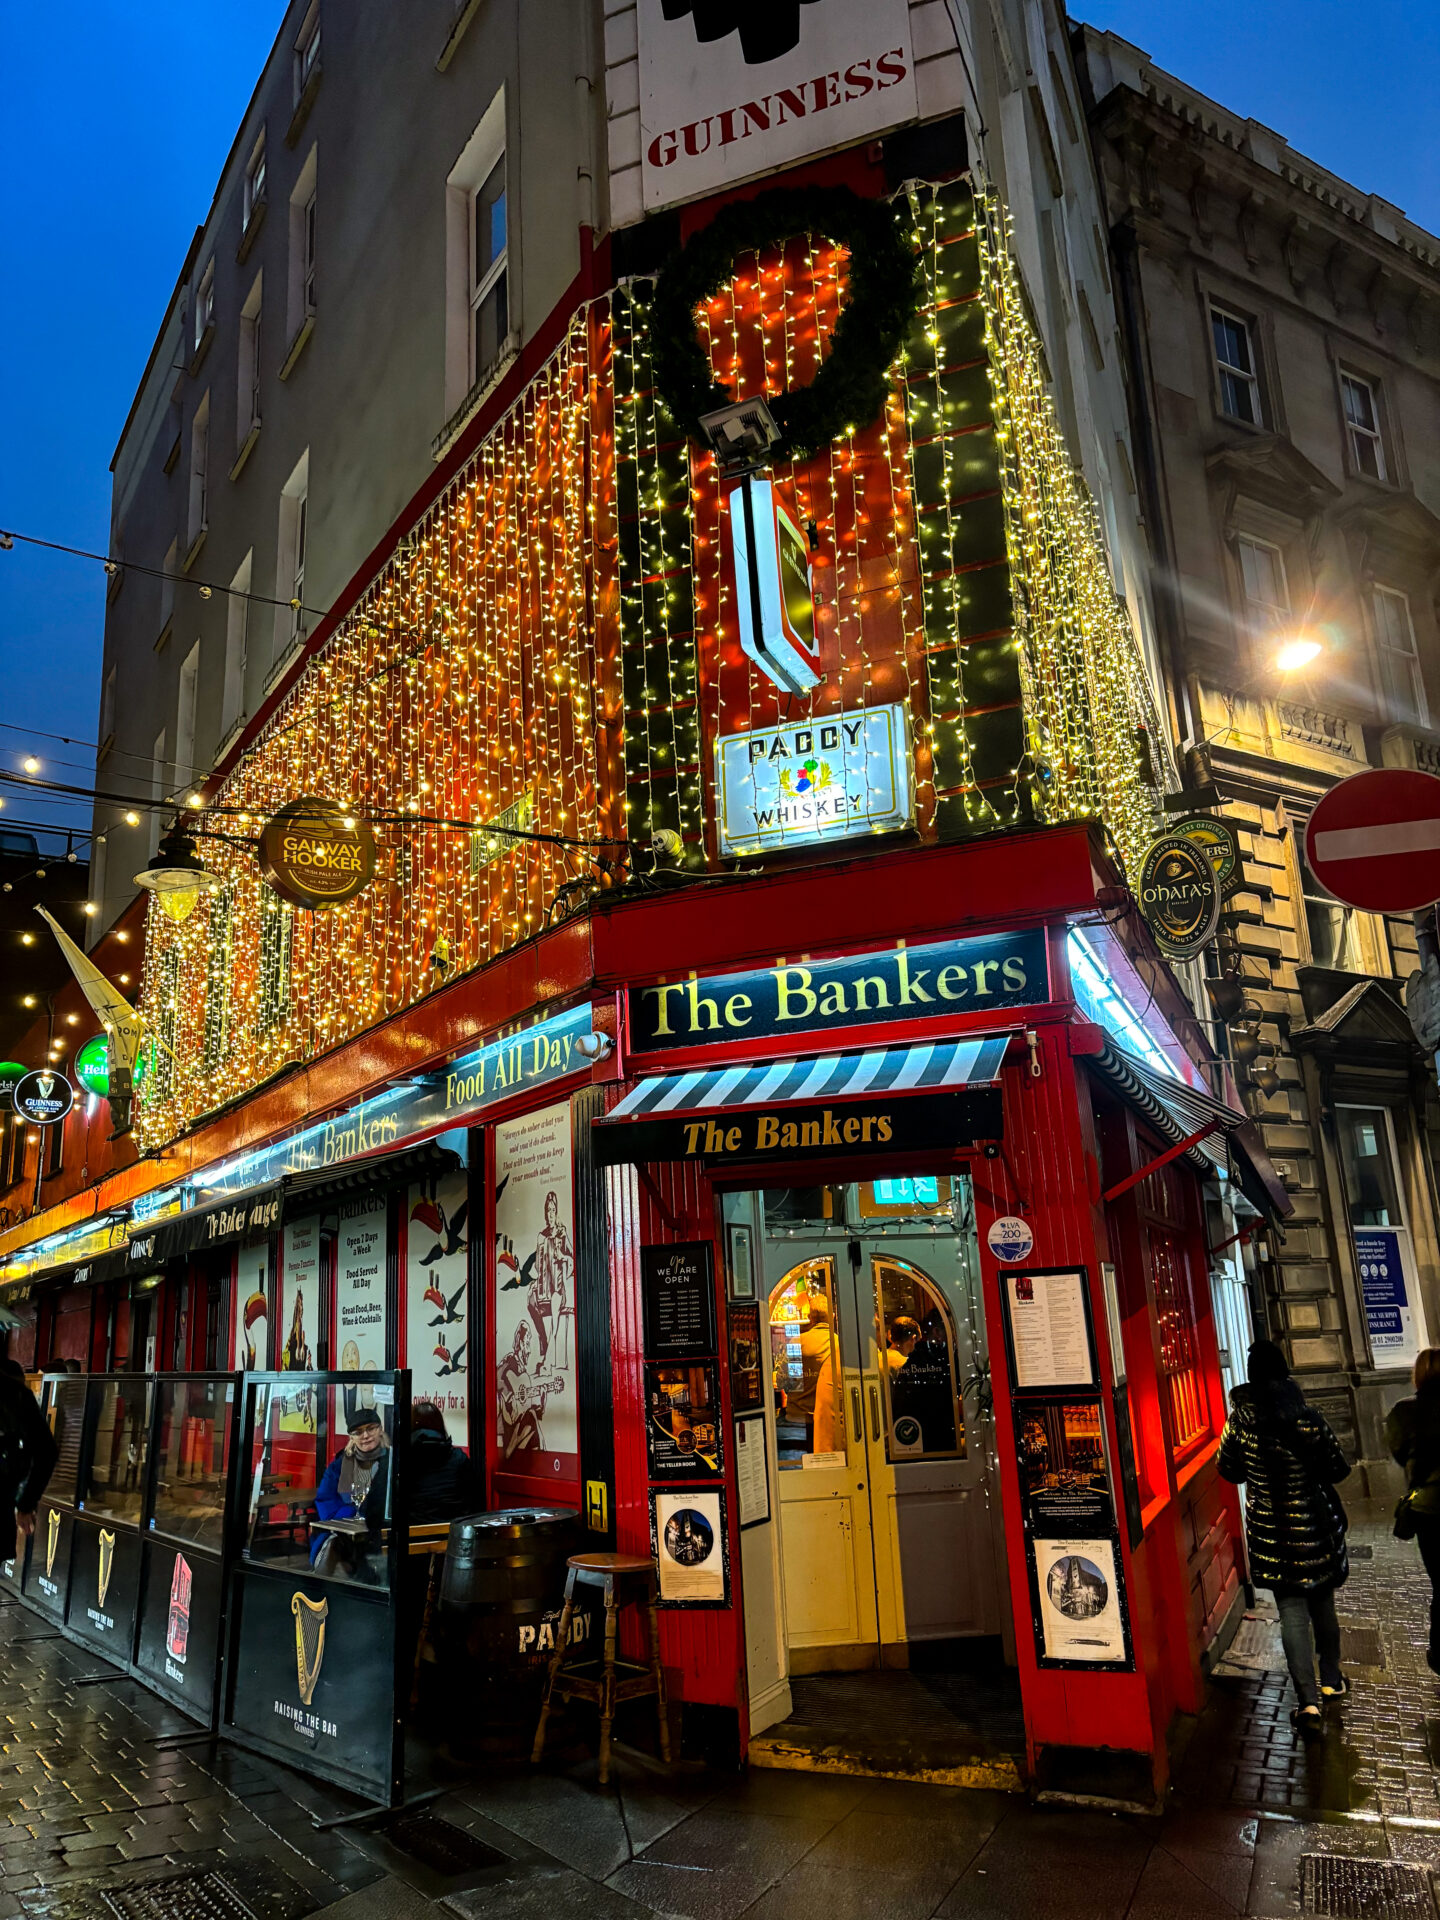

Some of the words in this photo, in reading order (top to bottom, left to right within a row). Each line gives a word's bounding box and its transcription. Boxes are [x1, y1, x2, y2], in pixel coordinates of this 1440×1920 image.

[648, 47, 907, 168] GUINNESS
[749, 720, 863, 766] PADDY
[752, 794, 862, 828] WHISKEY
[1196, 823, 1226, 839] ORIGINAL
[283, 836, 362, 858] GALWAY
[283, 850, 363, 871] HOOKER
[1145, 859, 1157, 880] CRAFT
[1155, 842, 1179, 859] BREWED
[1180, 843, 1189, 851] IN
[1188, 849, 1208, 876] IRELAND
[1152, 918, 1167, 936] IRISH
[1168, 934, 1194, 943] STOUTS
[1199, 913, 1210, 931] ALES
[642, 978, 753, 1037] The
[769, 951, 1028, 1023] Bankers
[445, 1066, 486, 1110] Food
[492, 1046, 523, 1092] All
[532, 1030, 575, 1073] Day
[25, 1098, 63, 1107] GUINNESS
[287, 1140, 316, 1171] The
[322, 1107, 399, 1166] Bankers
[683, 1119, 743, 1155] The
[755, 1110, 893, 1150] Bankers
[346, 1236, 361, 1249] Open
[361, 1233, 365, 1244] 7
[365, 1232, 379, 1244] Days
[1002, 1230, 1021, 1239] 200
[356, 1243, 372, 1256] Week
[346, 1267, 360, 1280] Food
[359, 1263, 378, 1277] Served
[657, 1268, 671, 1276] WE
[679, 1265, 697, 1275] ARE
[664, 1275, 690, 1284] OPEN
[352, 1279, 361, 1289] All
[360, 1278, 371, 1290] Day
[342, 1306, 355, 1315] Great
[355, 1303, 370, 1314] Food,
[369, 1302, 382, 1313] Beer,
[341, 1316, 354, 1326] Wine
[358, 1313, 382, 1325] Cocktails
[1368, 1320, 1396, 1329] INSURANCE
[413, 1390, 431, 1406] ovely
[433, 1390, 446, 1414] day
[447, 1390, 458, 1409] for
[460, 1395, 465, 1409] a
[518, 1612, 591, 1653] PADY
[274, 1700, 303, 1723] RAISING
[306, 1713, 320, 1730] THE
[322, 1720, 337, 1738] BAR
[293, 1721, 315, 1738] GUINNESS
